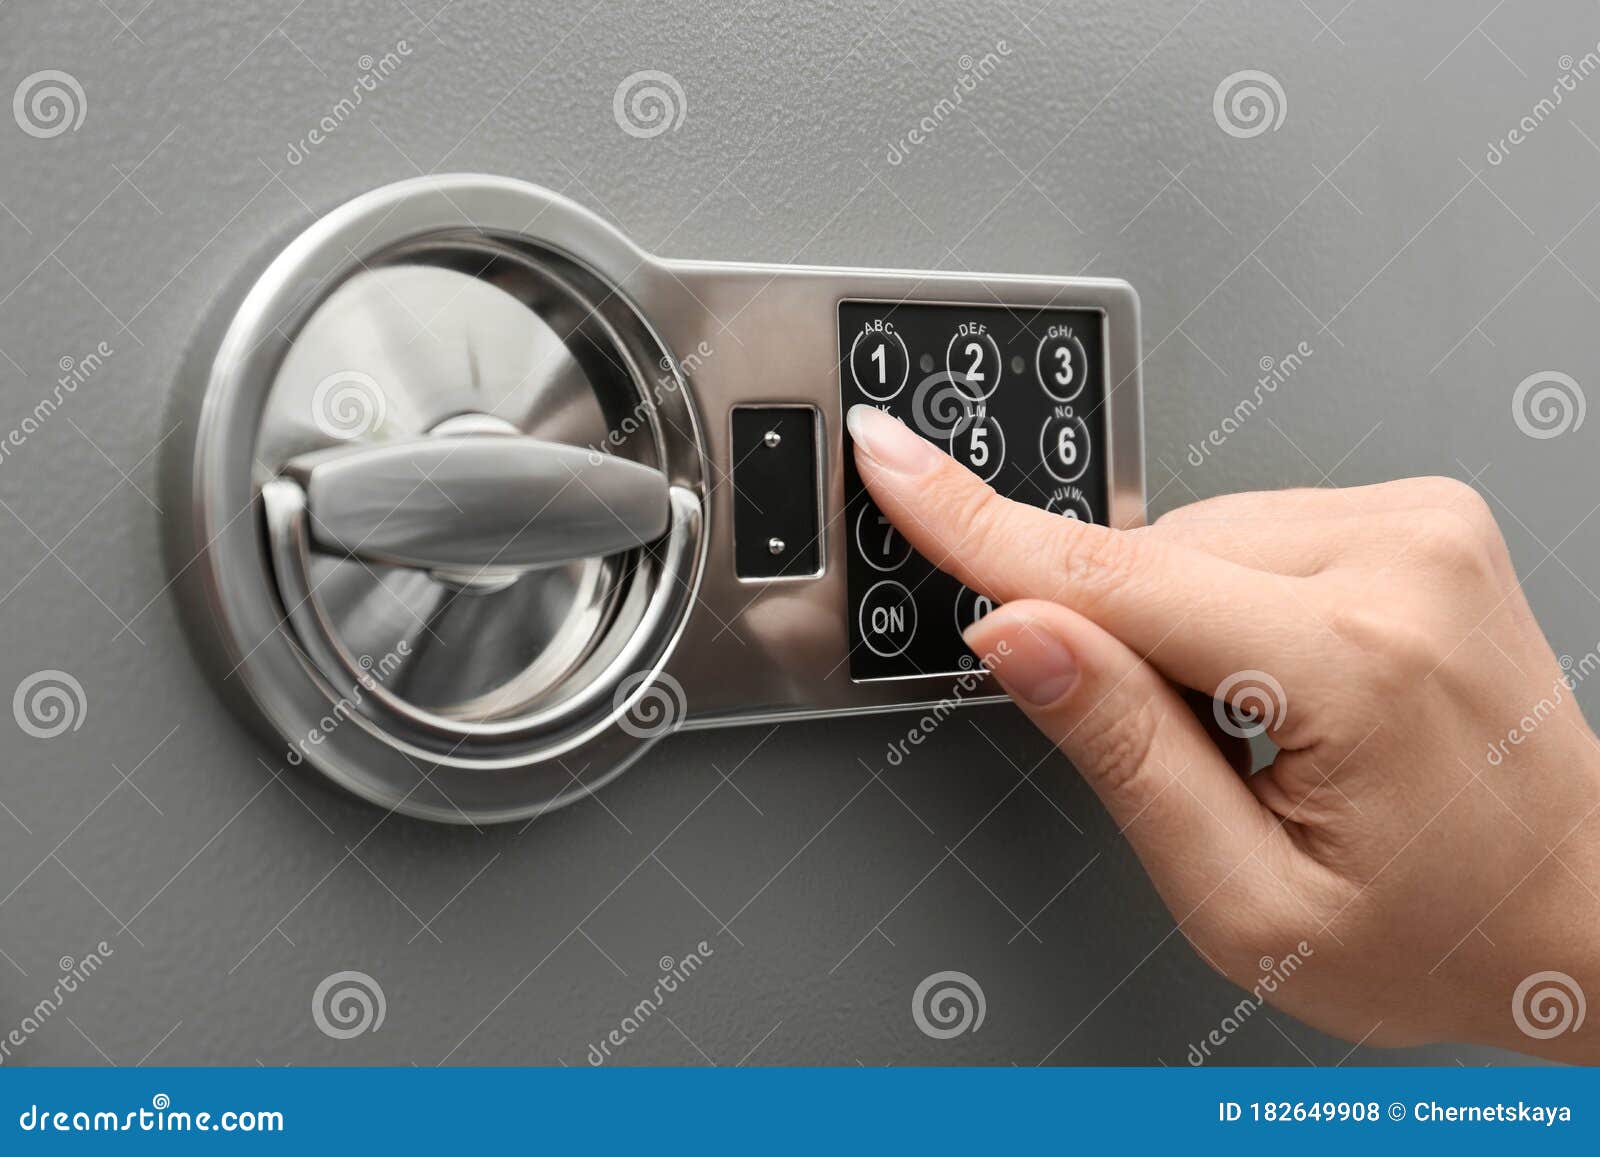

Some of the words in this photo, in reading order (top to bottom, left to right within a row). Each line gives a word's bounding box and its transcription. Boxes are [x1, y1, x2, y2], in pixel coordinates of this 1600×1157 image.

[864, 319, 894, 335] ABC
[958, 322, 987, 337] DEF
[1048, 324, 1073, 338] GHI
[871, 344, 886, 384] 1
[964, 343, 985, 381] 2
[1054, 347, 1073, 385] 3
[967, 405, 986, 418] LM
[1055, 406, 1073, 419] NO
[970, 427, 989, 466] 5
[1058, 426, 1077, 465] 6
[1054, 486, 1083, 501] UVW
[871, 606, 904, 634] ON
